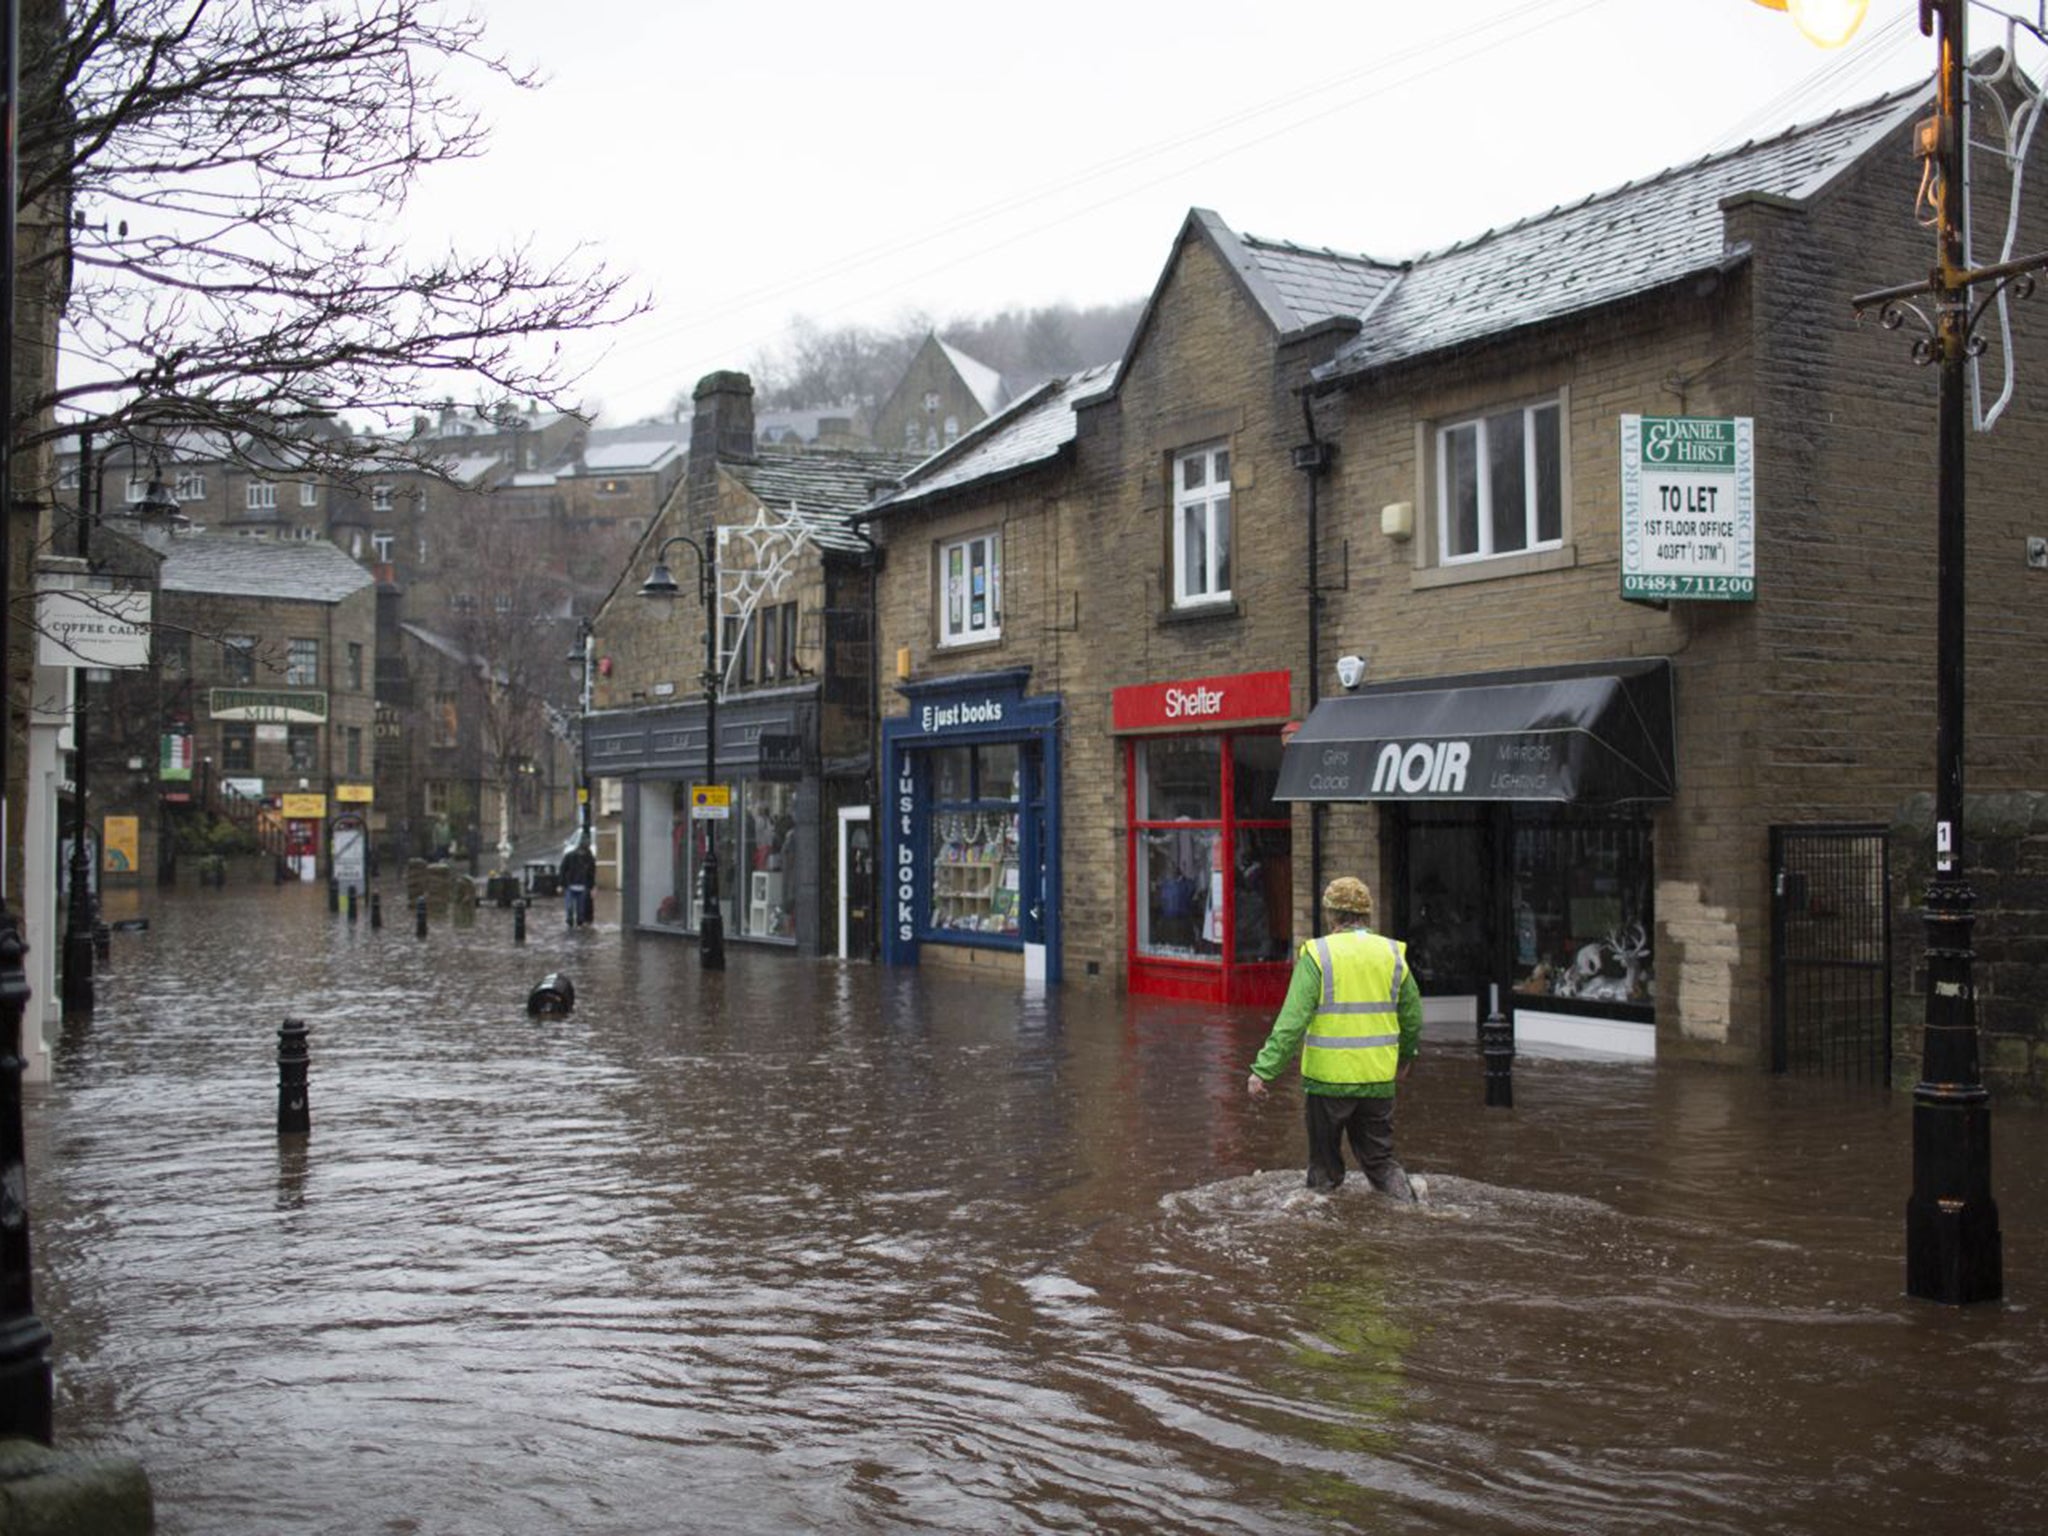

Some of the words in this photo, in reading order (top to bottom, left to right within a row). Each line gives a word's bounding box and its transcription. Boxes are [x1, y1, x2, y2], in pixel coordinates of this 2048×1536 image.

[1646, 424, 1676, 462] &
[1677, 441, 1726, 462] HIRST
[1666, 419, 1725, 440] DANIEL
[1625, 419, 1640, 572] COMMERCIAL
[1659, 485, 1681, 512] TO
[1687, 486, 1718, 513] LET
[1737, 422, 1752, 575] COMMERCIAL
[1644, 520, 1662, 536] 1ST
[1665, 521, 1697, 536] FLOOR
[1699, 521, 1734, 537] OFFICE
[1625, 575, 1677, 591] 01484
[1681, 577, 1753, 592] 711200
[53, 622, 104, 634] COFFEE
[933, 705, 959, 732] just
[961, 699, 1002, 723] books
[1166, 686, 1224, 717] Shelter
[1371, 741, 1471, 793] NOIR
[1498, 744, 1552, 761] MIRRORS
[899, 751, 913, 835] just
[1309, 774, 1349, 790] CLOCKS
[1939, 827, 1947, 842] 1
[899, 844, 914, 941] books
